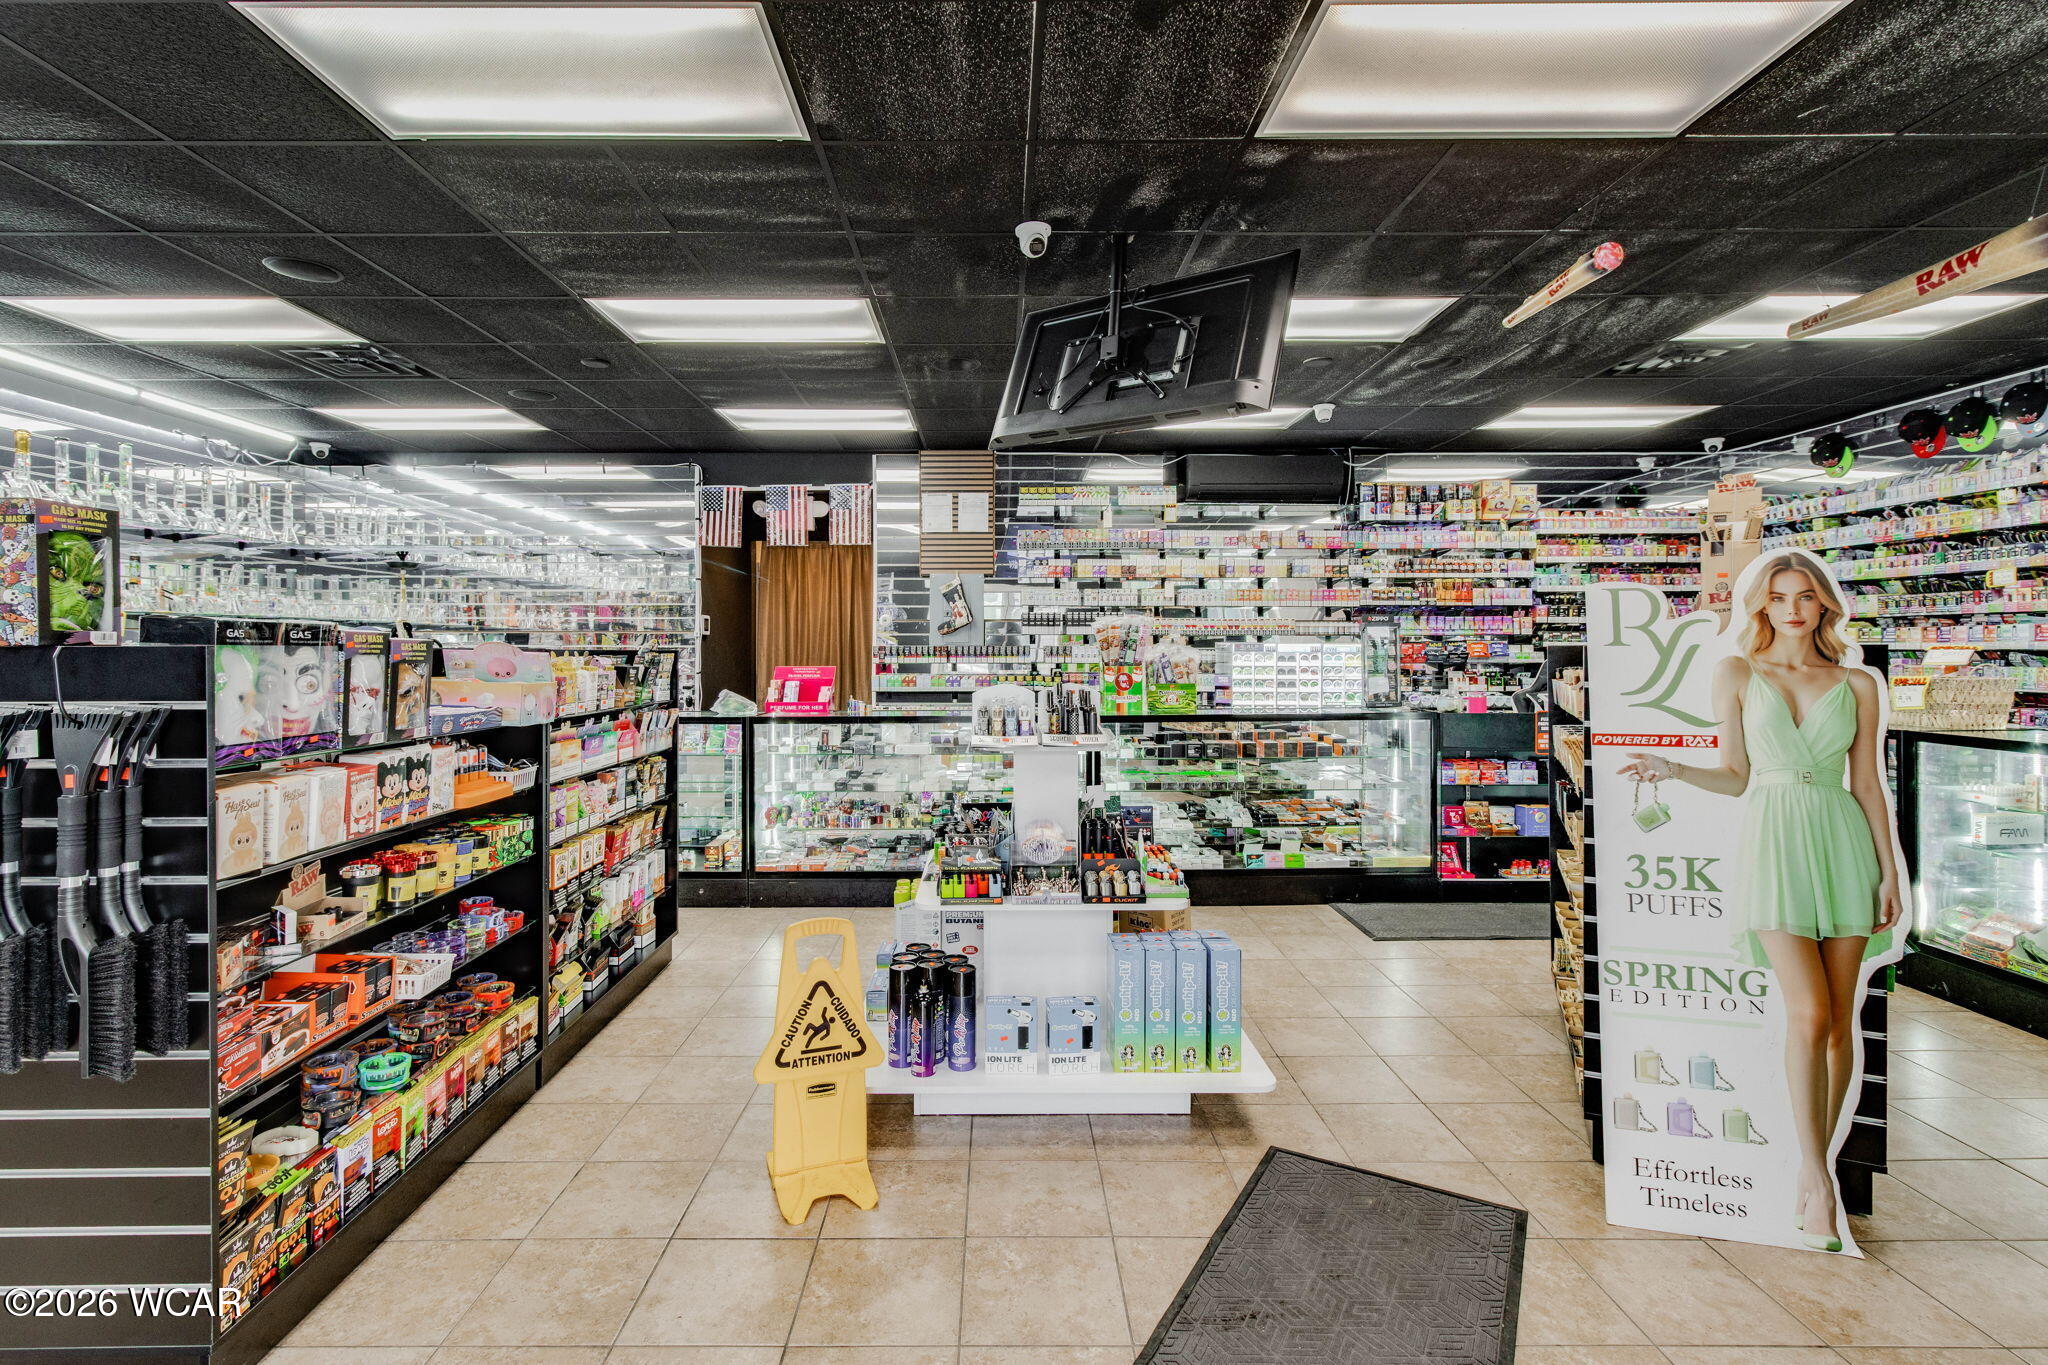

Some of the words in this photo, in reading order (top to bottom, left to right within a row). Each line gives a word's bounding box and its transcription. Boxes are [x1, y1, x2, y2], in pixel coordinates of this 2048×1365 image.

[1916, 240, 1992, 296] RAW
[1802, 313, 1829, 331] RAW
[1717, 480, 1757, 493] RAW
[5, 515, 27, 523] MASK
[51, 504, 75, 517] GAS
[77, 510, 107, 522] MASK
[227, 629, 245, 638] GAS
[290, 631, 311, 639] GAS
[354, 634, 367, 643] GAS
[1594, 735, 1660, 745] POWERED
[1661, 736, 1680, 745] BY
[1683, 736, 1714, 748] RAZ
[289, 867, 320, 896] RAW
[1624, 854, 1722, 893] 35K
[1626, 893, 1722, 918] PUFFS
[1603, 960, 1769, 997] SPRING
[1610, 988, 1764, 1014] EDITION
[781, 999, 812, 1048] CAUTION
[831, 997, 861, 1038] CUIDADO
[792, 1051, 851, 1069] ATTENTION
[988, 1063, 1034, 1072] TORCH
[1053, 1063, 1098, 1073] TORCH
[378, 1117, 398, 1137] LOADED
[1633, 1157, 1752, 1190] Effortless
[315, 1197, 341, 1226] GOJI
[1640, 1186, 1748, 1218] Timeless
[280, 1223, 307, 1252] GOJI
